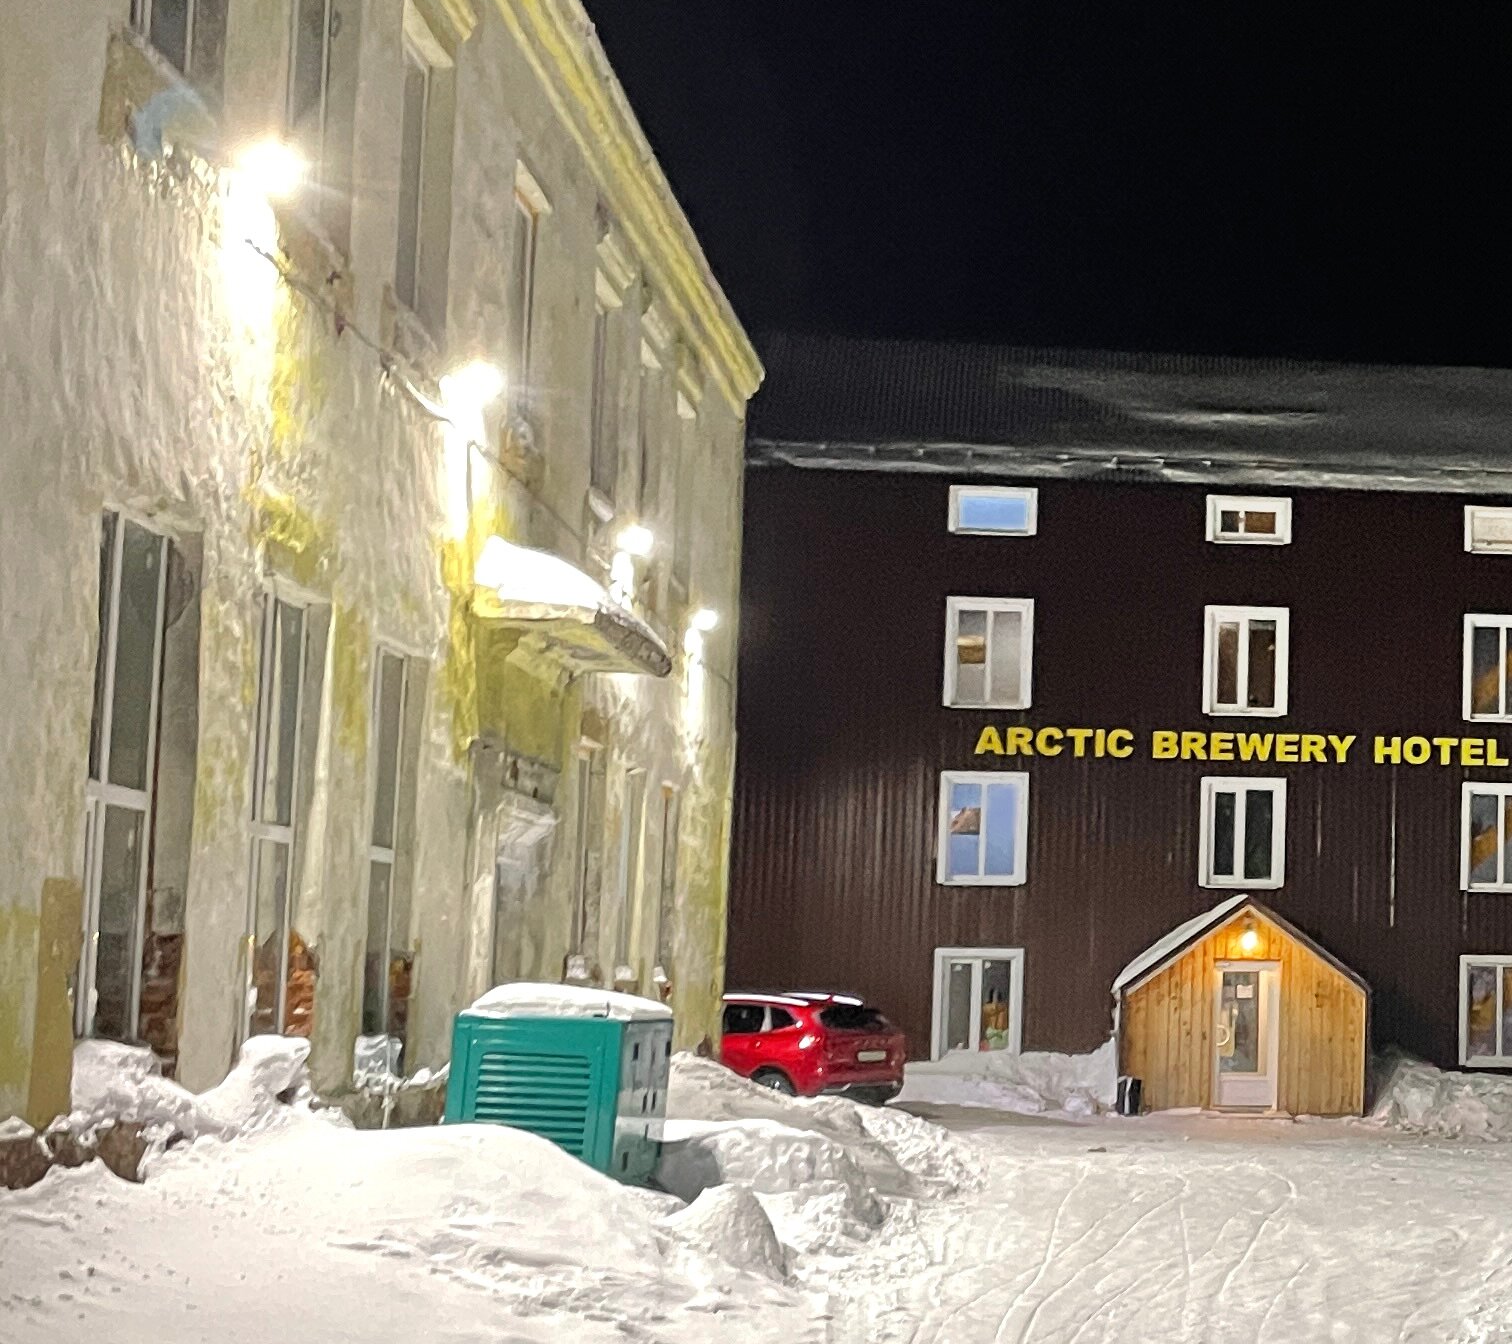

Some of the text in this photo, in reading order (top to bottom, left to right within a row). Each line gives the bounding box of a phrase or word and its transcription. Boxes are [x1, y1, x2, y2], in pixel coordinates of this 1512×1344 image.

[975, 725, 1509, 766] ARCTIC BREWERY HOTEL
